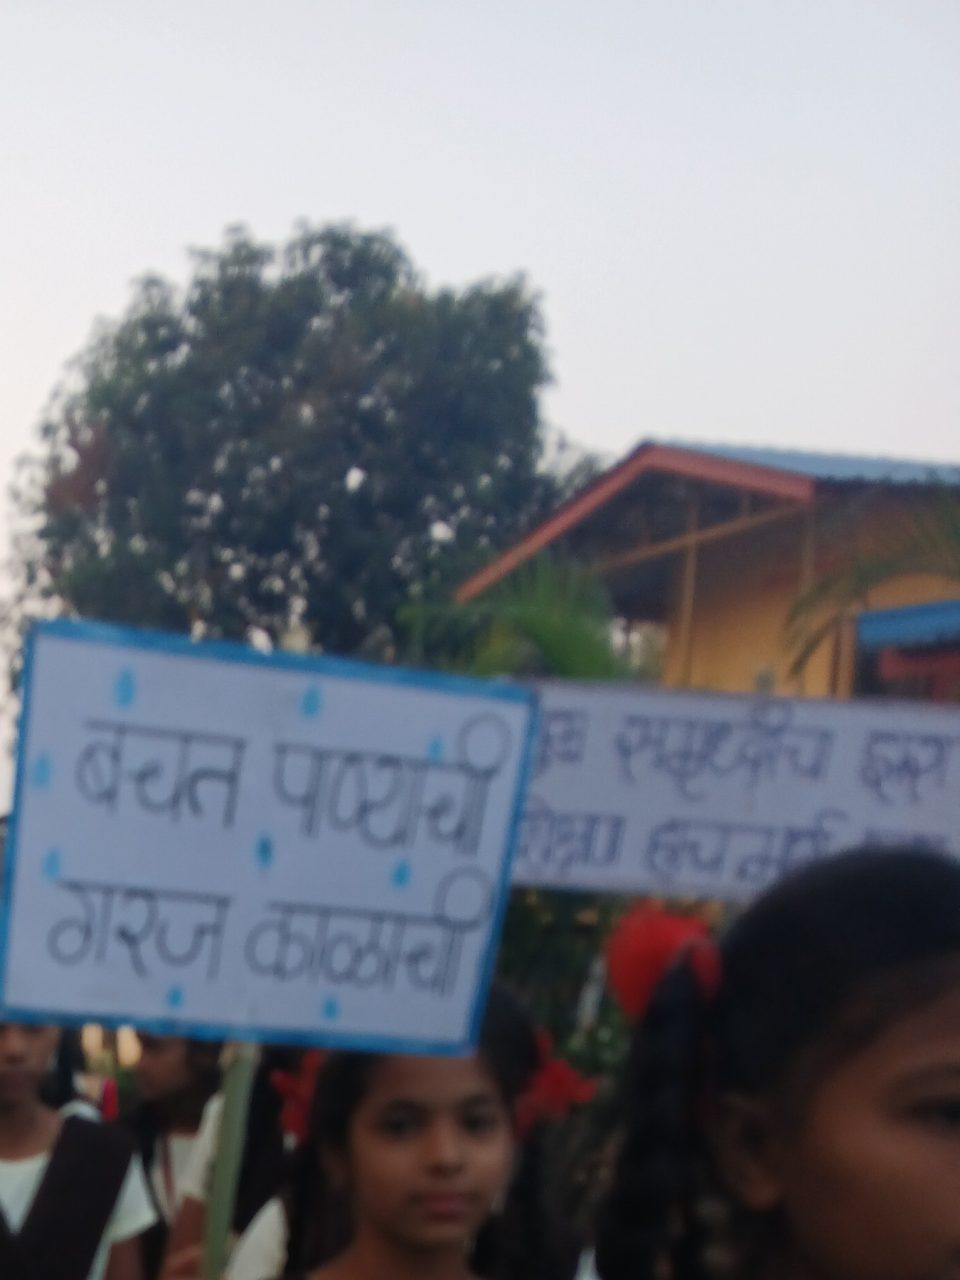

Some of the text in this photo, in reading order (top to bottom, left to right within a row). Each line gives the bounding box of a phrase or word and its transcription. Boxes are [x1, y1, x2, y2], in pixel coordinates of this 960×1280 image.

[74, 718, 248, 830] बचत
[45, 865, 493, 997] गरज काळाची
